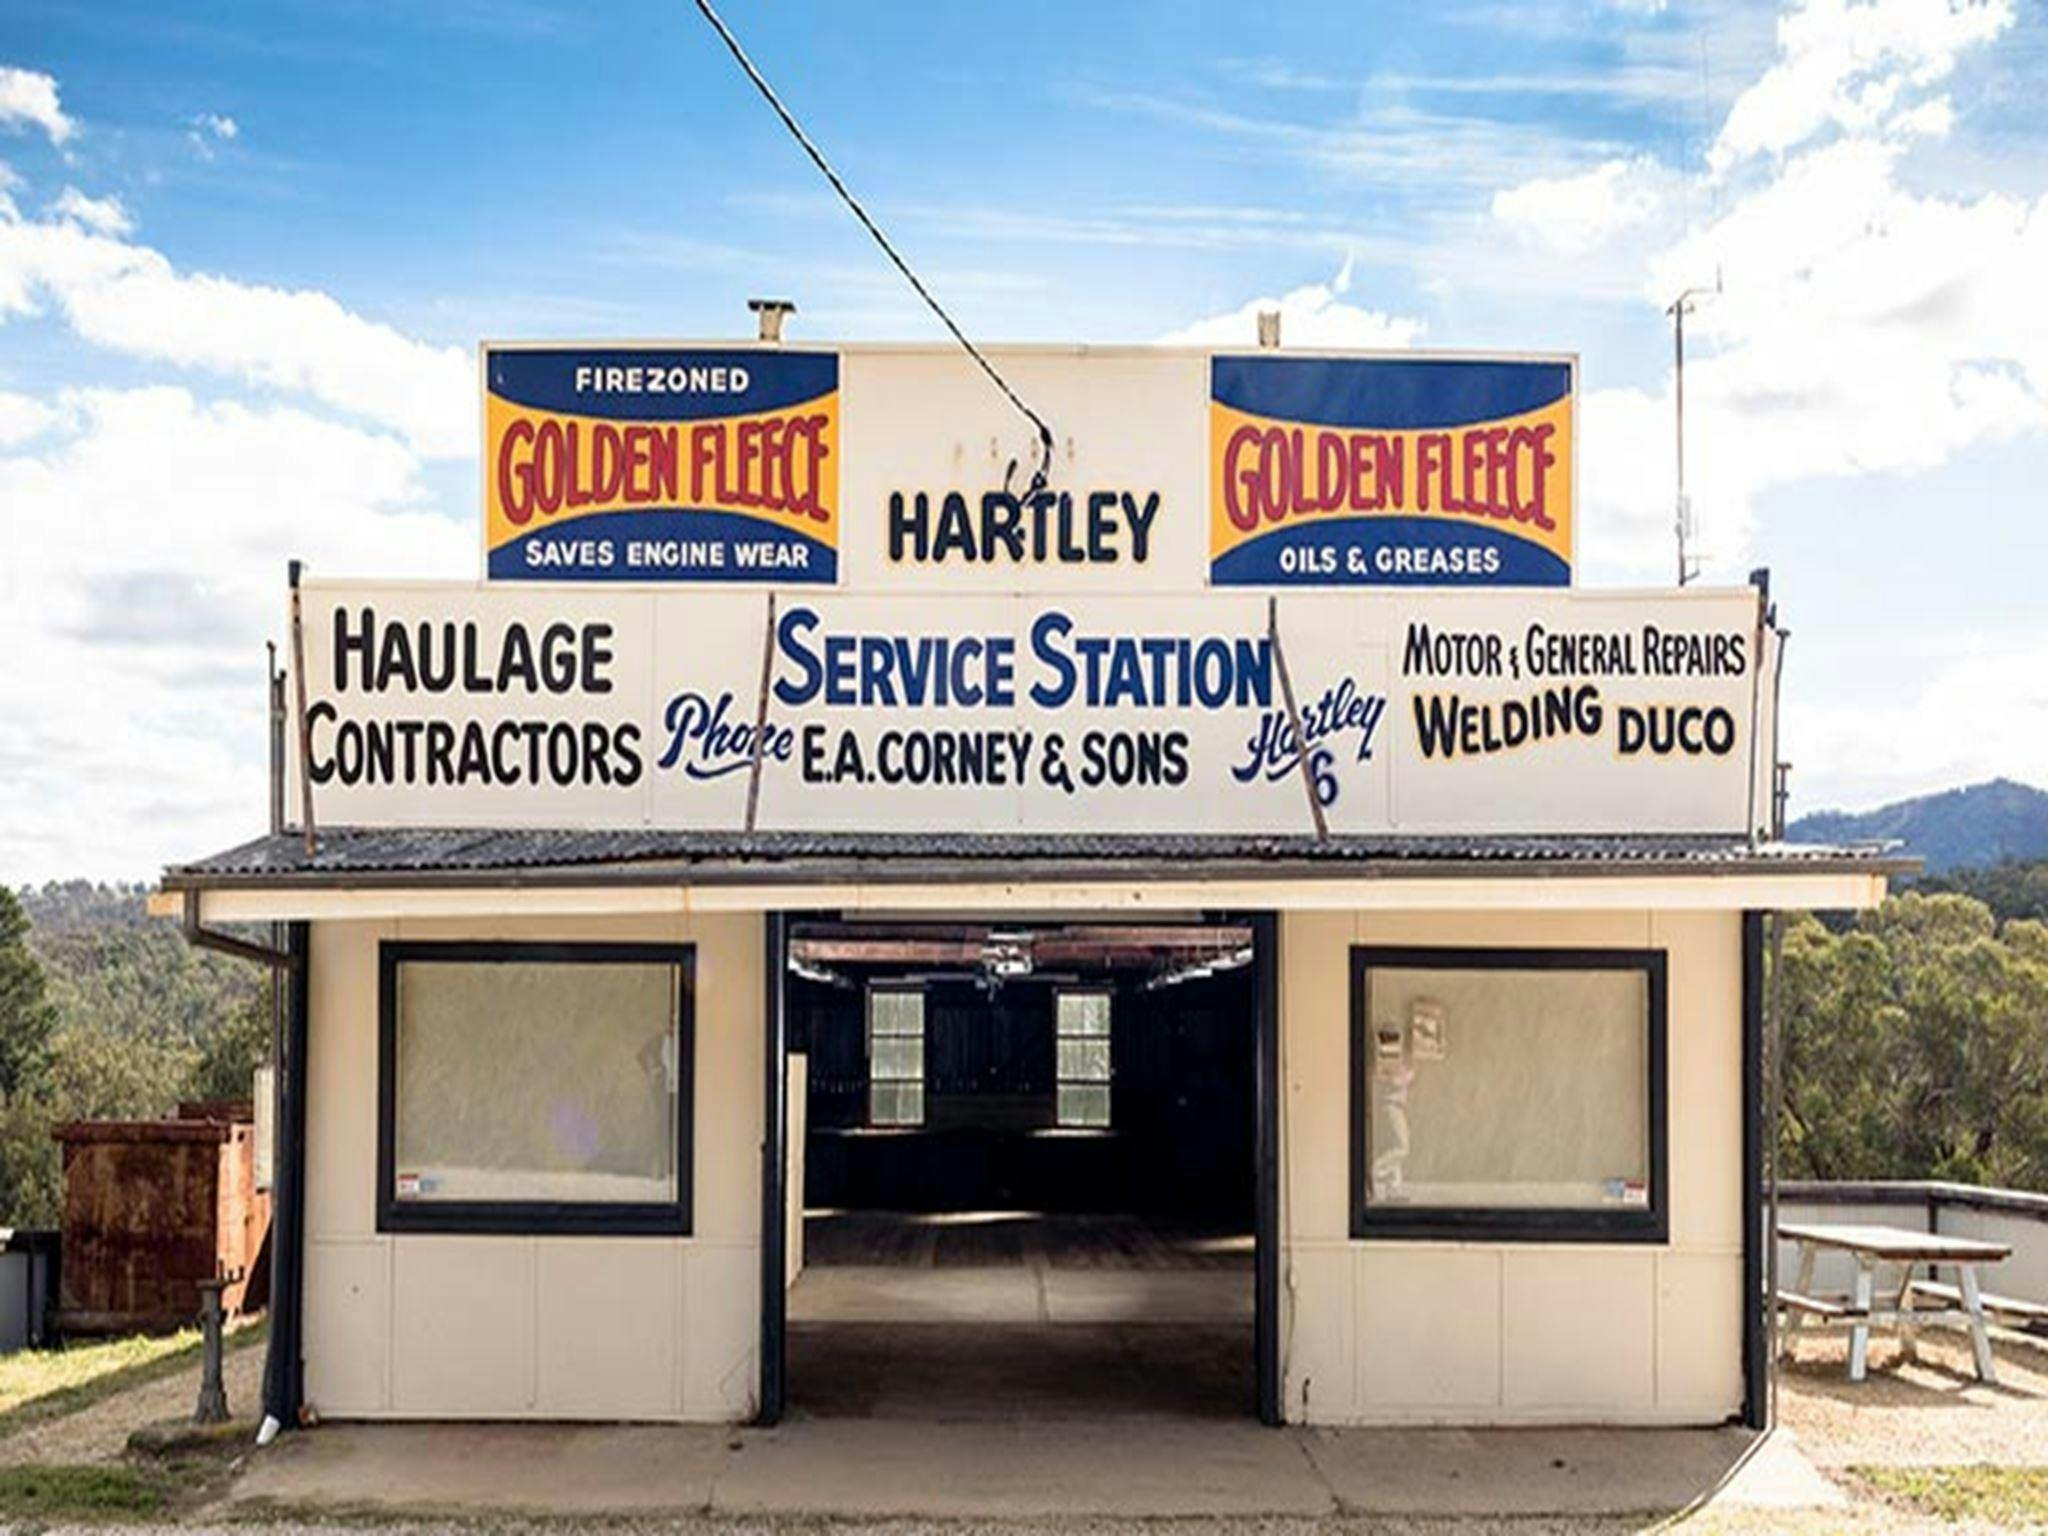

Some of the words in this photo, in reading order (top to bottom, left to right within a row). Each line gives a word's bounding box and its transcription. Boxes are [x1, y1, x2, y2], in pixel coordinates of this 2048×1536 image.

[575, 367, 750, 392] FIREZONED
[499, 418, 678, 526] GOLDEN
[691, 414, 830, 523] FLEECE
[1223, 425, 1401, 532] GOLDEN
[1416, 423, 1555, 531] FLEECE
[526, 540, 614, 566] SAVES
[627, 541, 724, 567] ENGINE
[735, 542, 809, 567] WEAR
[889, 491, 1160, 563] HARTLEY
[1280, 547, 1337, 574] OILS
[1346, 547, 1368, 574] &
[1376, 547, 1499, 574] GREASES
[334, 607, 614, 693] HAULAGE
[773, 608, 1015, 708] SERVICE
[1030, 612, 1272, 708] STATION
[1403, 622, 1502, 676] MOTOR
[1526, 623, 1637, 677] GENERAL
[1643, 626, 1746, 676] REPAIRS
[306, 700, 642, 785] CONTRACTORS
[657, 692, 795, 779] Phone
[1413, 685, 1604, 758] WELDING
[1618, 707, 1735, 755] DUCO
[1040, 733, 1075, 794] &
[1081, 731, 1189, 786] SONS
[1311, 750, 1338, 807] 6
